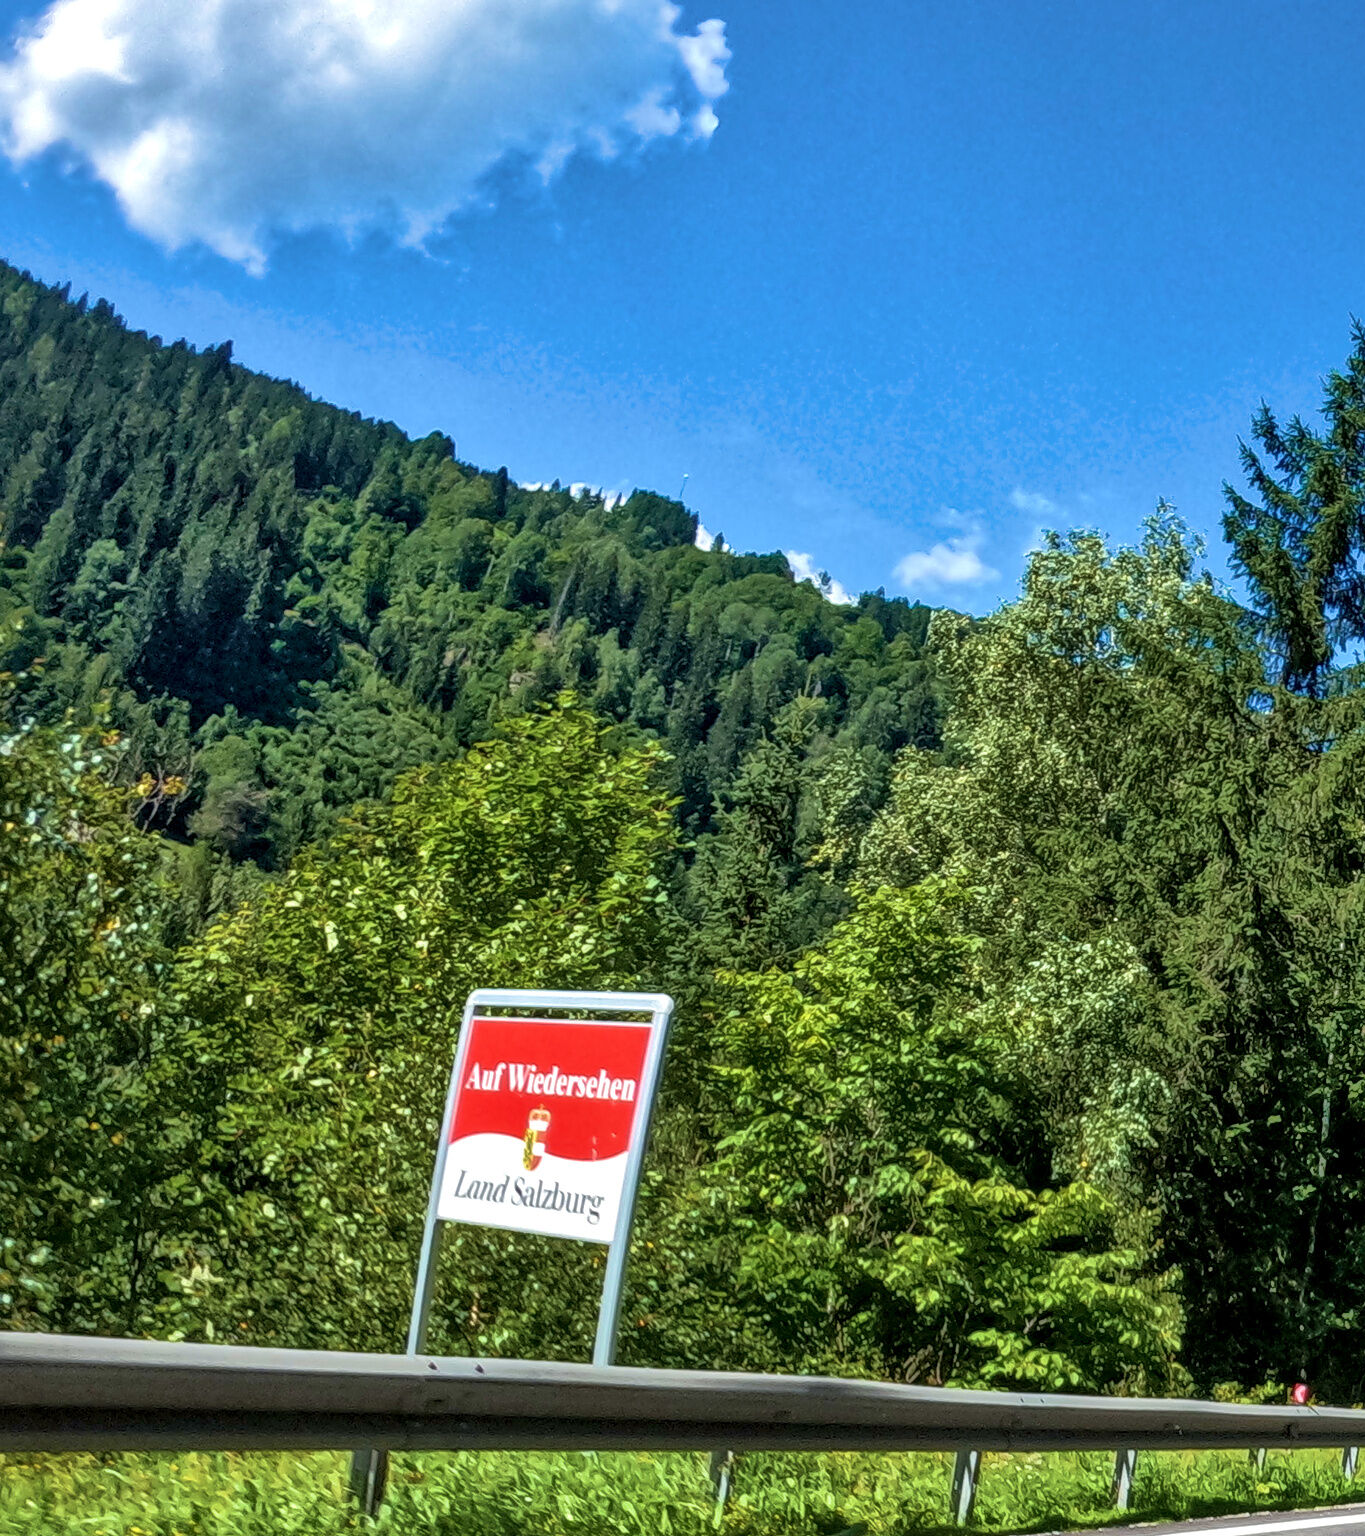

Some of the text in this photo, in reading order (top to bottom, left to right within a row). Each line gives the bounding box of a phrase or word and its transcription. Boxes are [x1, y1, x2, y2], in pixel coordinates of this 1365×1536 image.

[465, 1062, 636, 1102] Auf Wiedersehen
[454, 1169, 605, 1225] Land Salzburg
